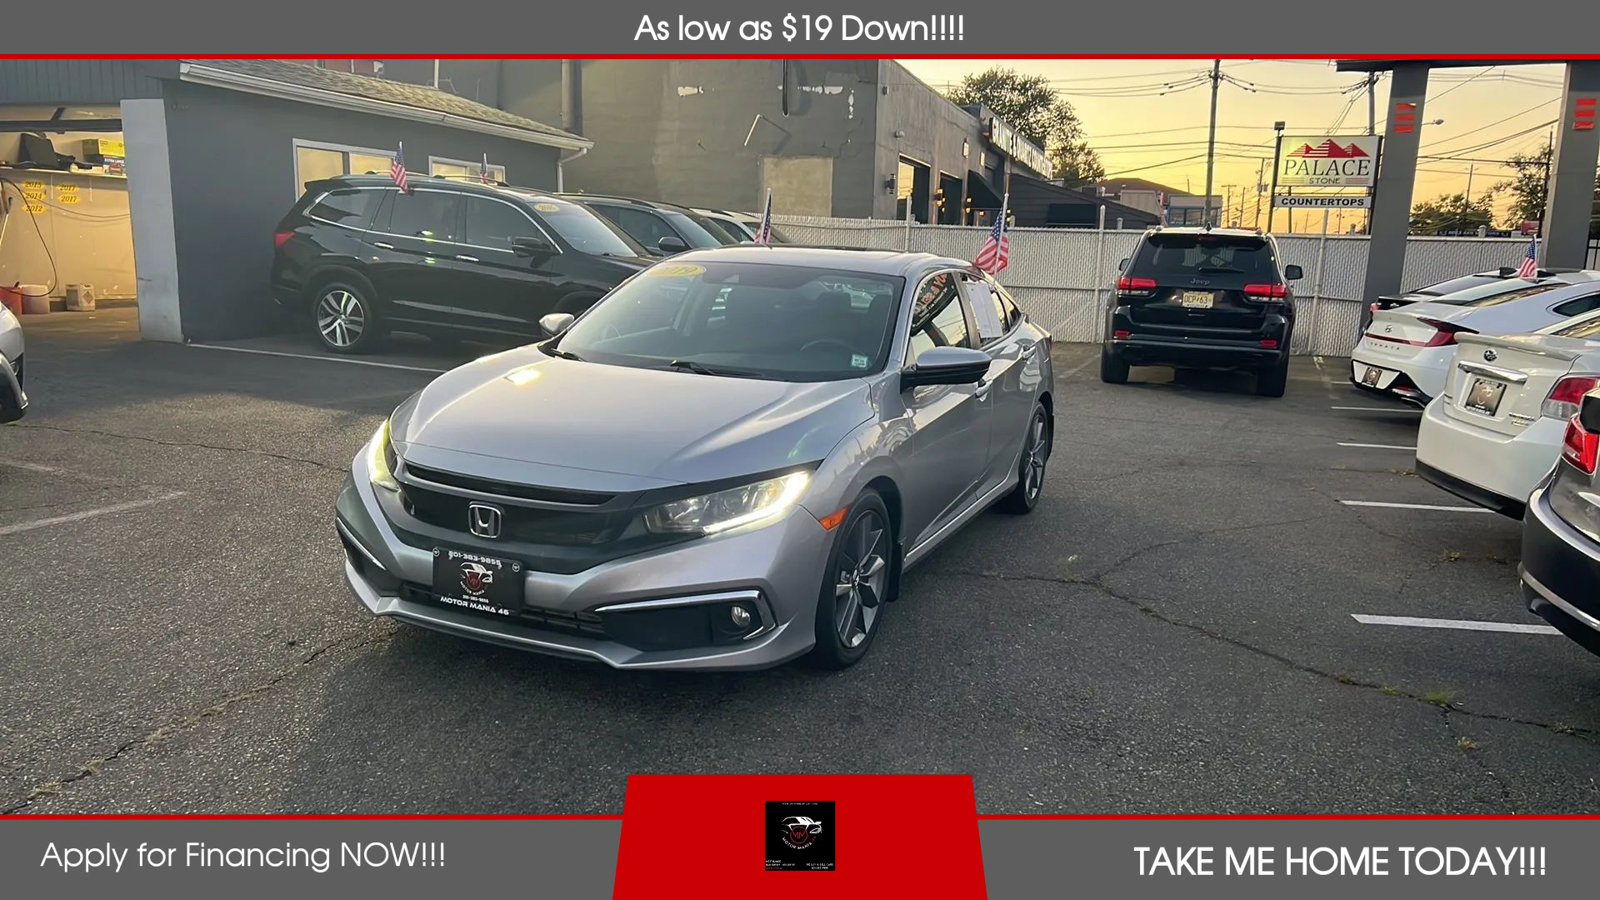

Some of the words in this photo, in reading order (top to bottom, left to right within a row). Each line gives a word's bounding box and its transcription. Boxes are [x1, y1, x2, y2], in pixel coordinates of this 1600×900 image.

[1285, 160, 1370, 176] PALACE
[1282, 198, 1364, 206] COUNTERTOPS
[440, 596, 468, 608] MOTOR
[469, 602, 496, 613] MANIA
[497, 608, 510, 616] 46
